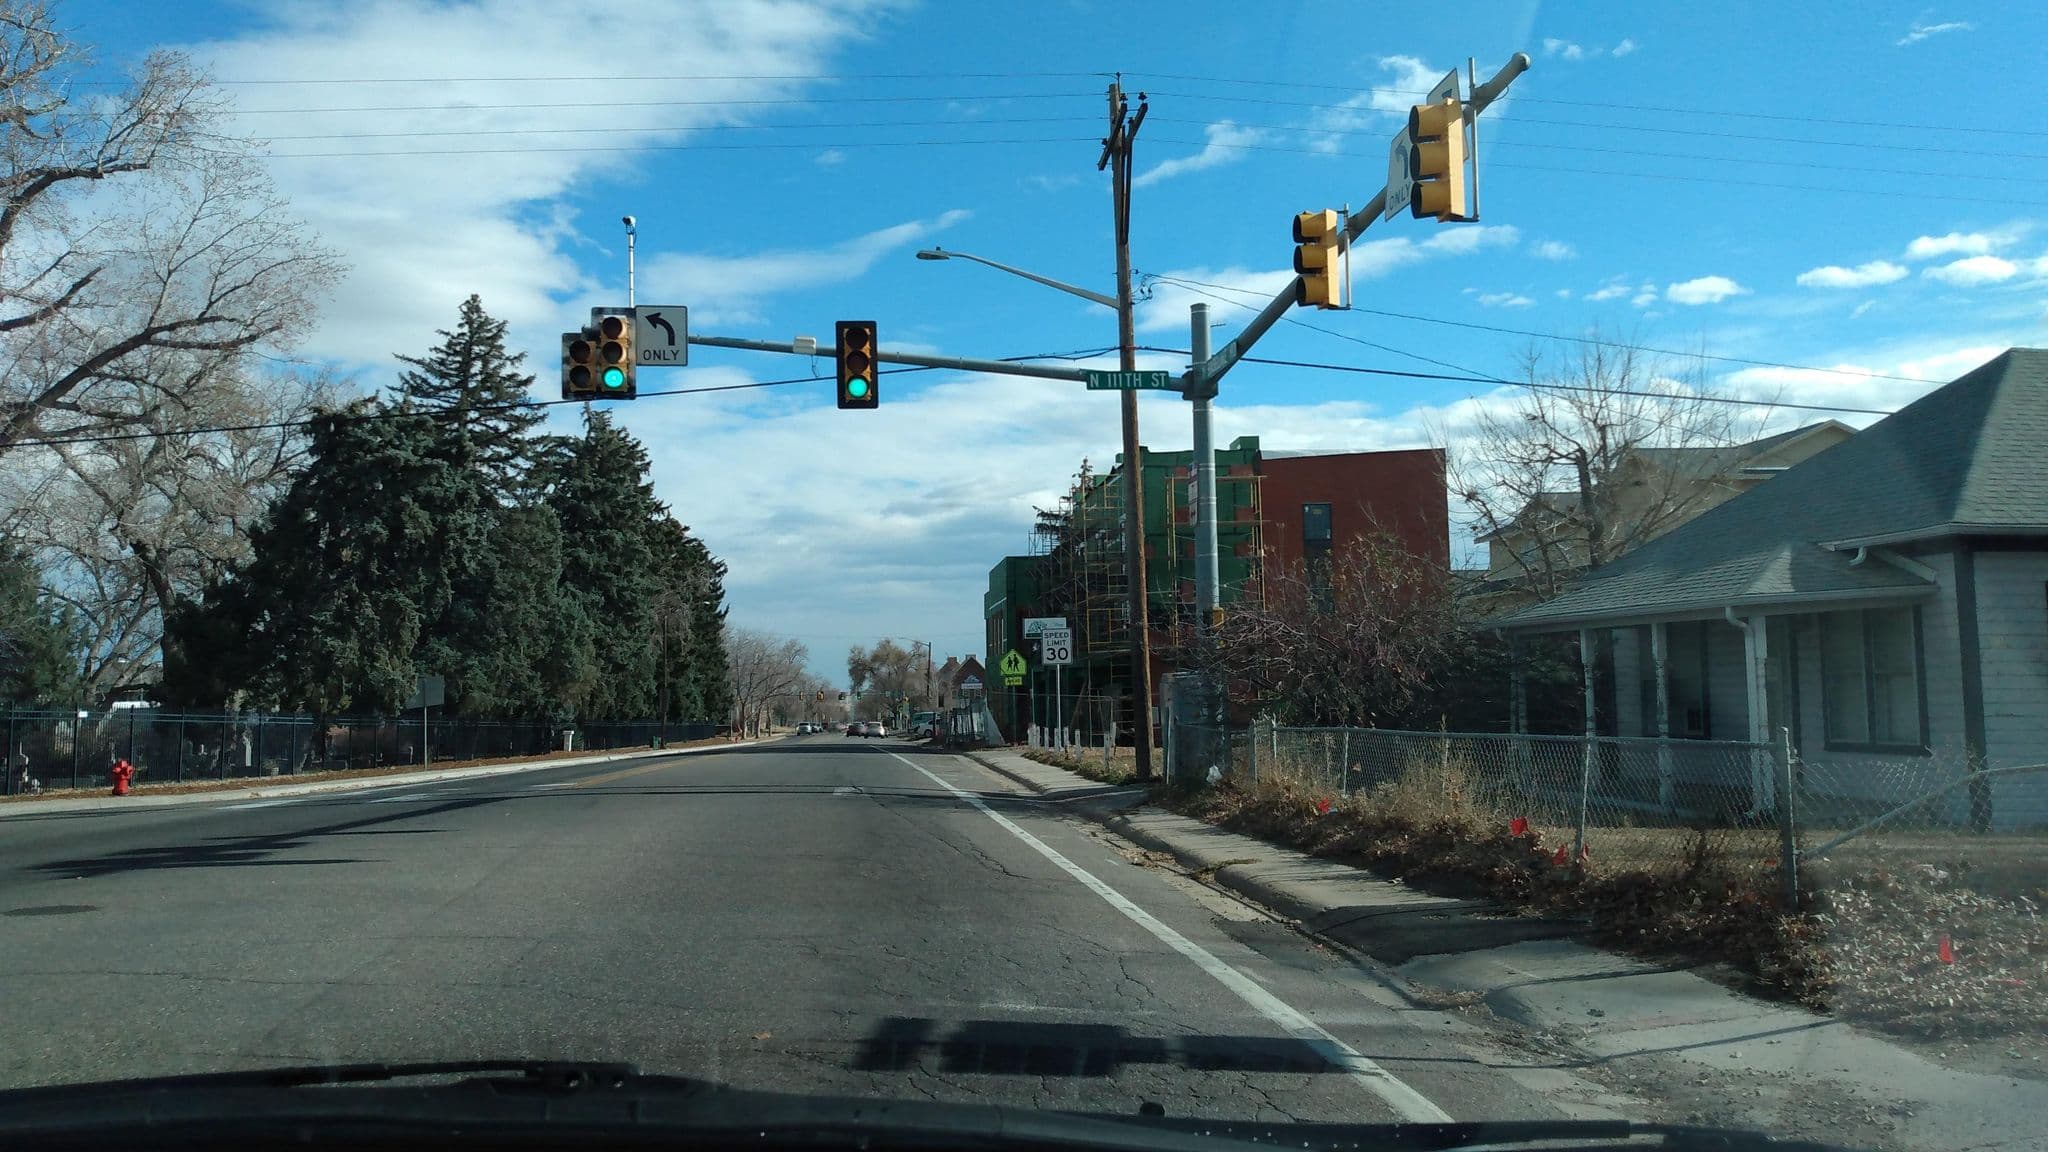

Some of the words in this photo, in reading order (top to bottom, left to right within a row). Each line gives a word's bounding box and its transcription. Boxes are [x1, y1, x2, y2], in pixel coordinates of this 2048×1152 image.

[1389, 182, 1411, 210] ONLY
[643, 349, 680, 361] ONLY
[1090, 373, 1099, 388] N
[1107, 373, 1142, 388] 111TH
[1151, 372, 1167, 388] ST
[1044, 631, 1069, 639] SPEED
[1046, 647, 1068, 661] 30
